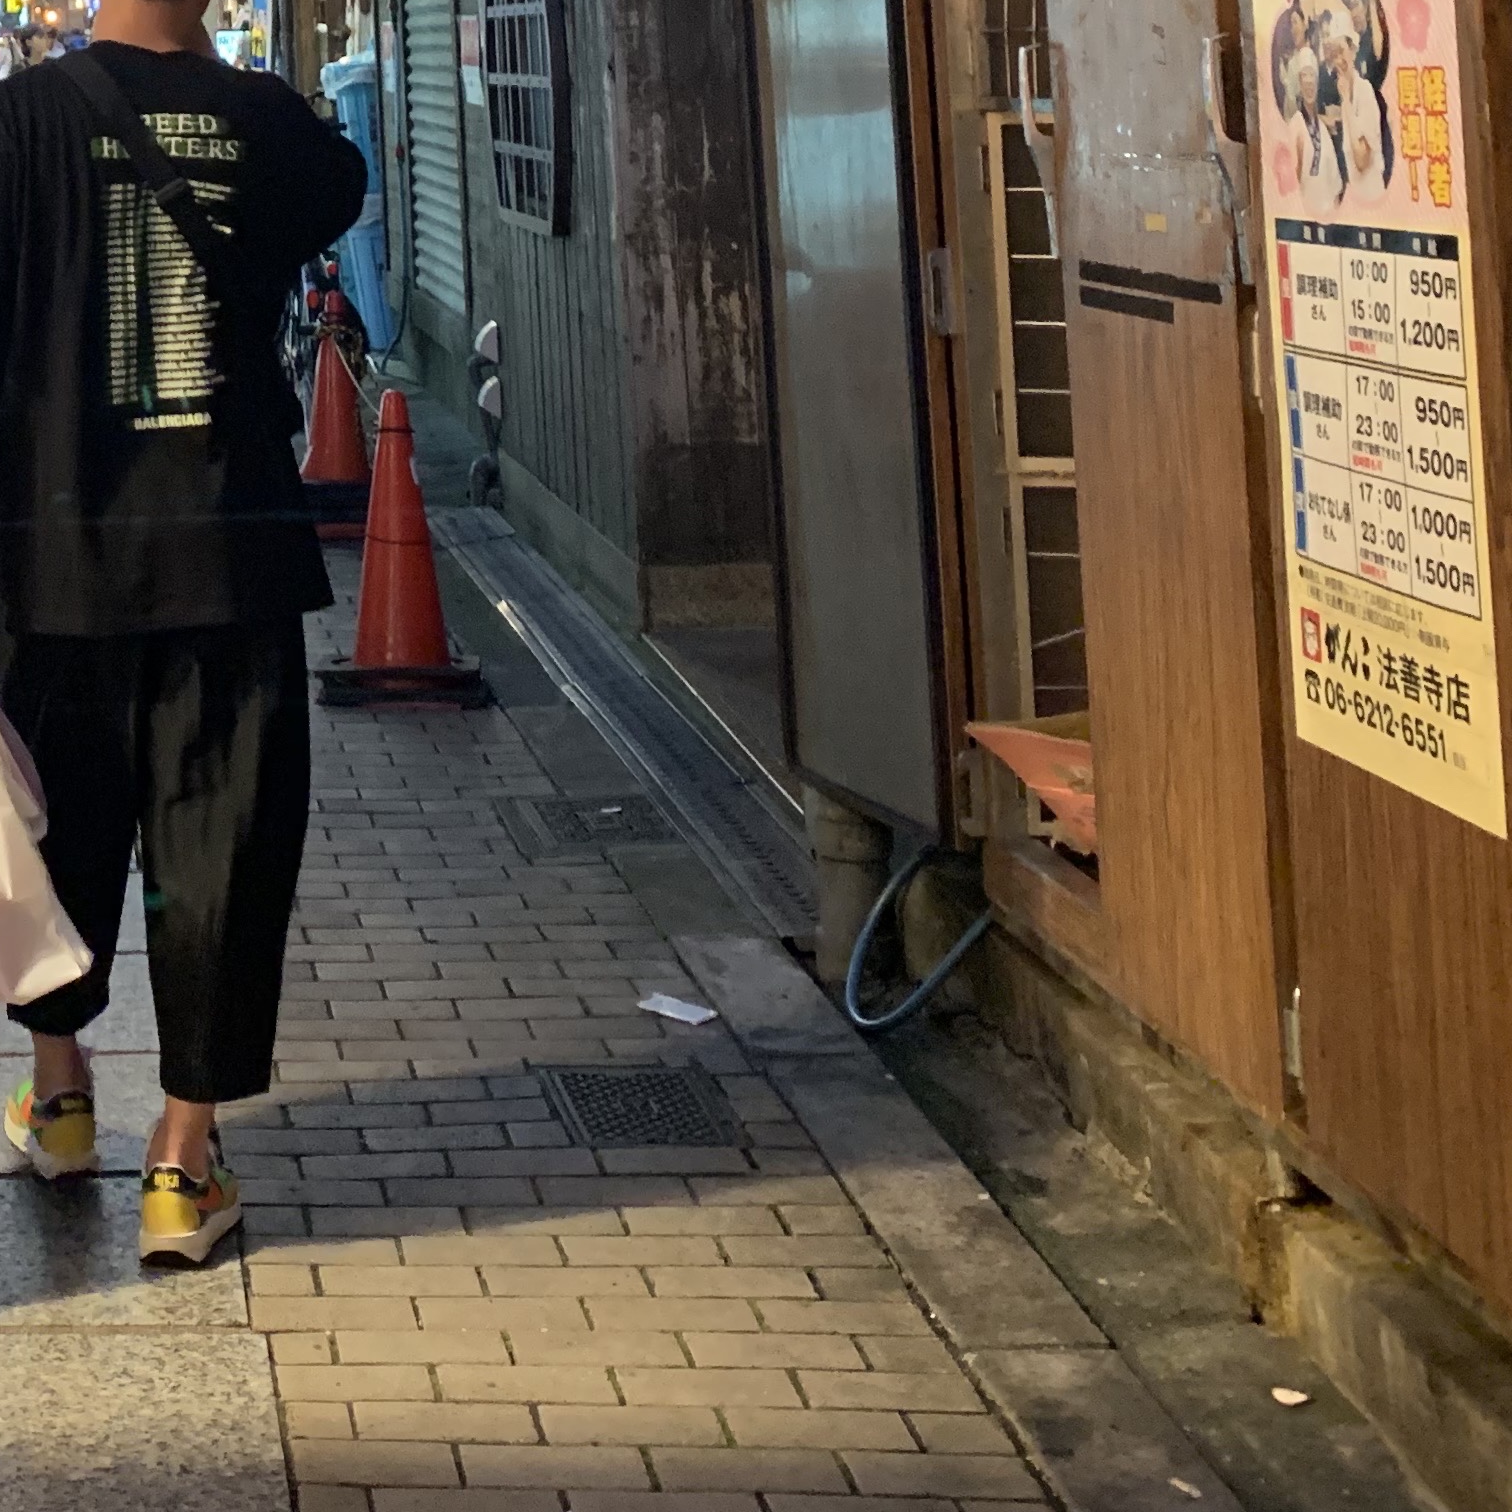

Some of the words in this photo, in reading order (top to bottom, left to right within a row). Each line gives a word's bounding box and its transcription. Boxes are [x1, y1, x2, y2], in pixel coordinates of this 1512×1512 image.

[140, 113, 217, 135] EED
[101, 135, 240, 160] HTERS
[1349, 258, 1388, 283] 10:00
[1410, 269, 1457, 300] 950円
[1351, 299, 1391, 324] 15:00
[1356, 375, 1395, 403] 17:00
[1355, 413, 1398, 443] 23:00
[1414, 395, 1466, 431] 950円
[1358, 481, 1402, 512] 17:00
[1360, 520, 1406, 554] 23:00
[1376, 643, 1472, 727] 法善寺店
[1324, 677, 1448, 763] 06-6212-6551
[154, 1174, 180, 1189] NIKE
